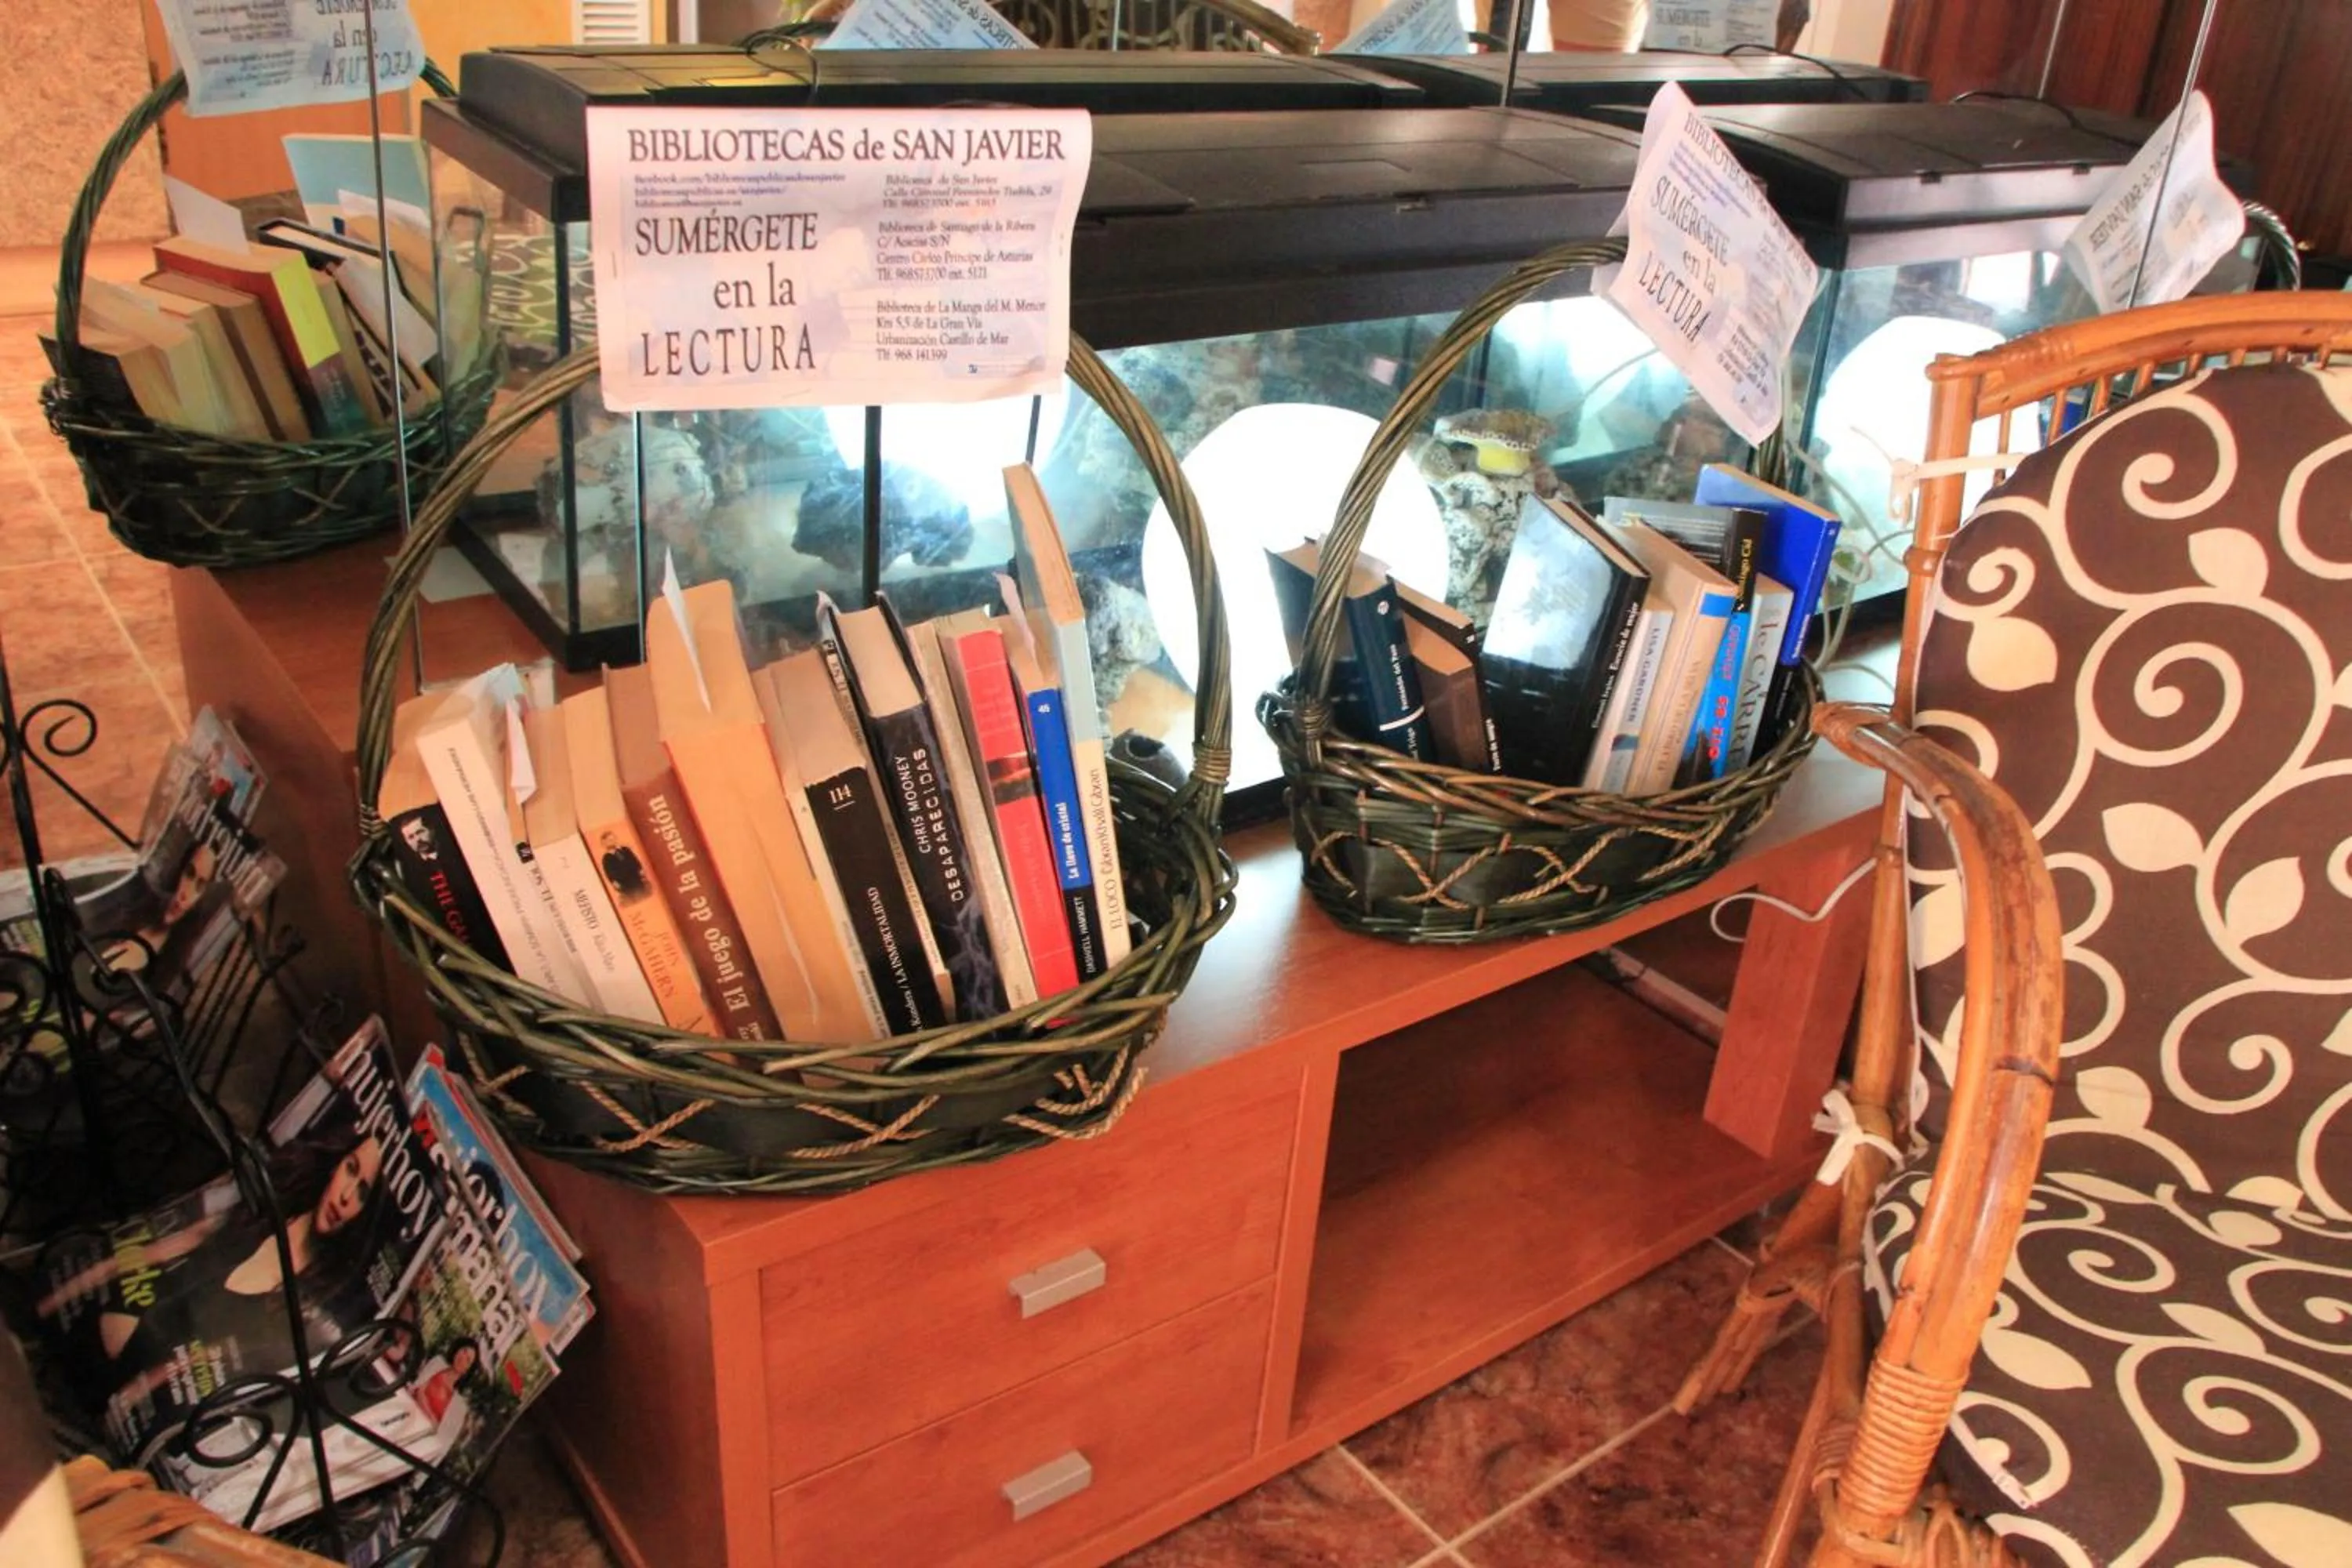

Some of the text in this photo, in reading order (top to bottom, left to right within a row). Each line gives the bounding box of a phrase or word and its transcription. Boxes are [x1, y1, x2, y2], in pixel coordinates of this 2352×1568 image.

[627, 128, 1066, 167] BIBLIOTECAS de SAN JAVIER
[635, 208, 818, 256] SUMÉRGETE
[926, 221, 938, 233] de
[1650, 176, 1731, 267] SUMÉRGETE
[983, 251, 995, 263] de
[1682, 249, 1718, 296] en la
[713, 261, 797, 310] en la
[877, 300, 922, 314] Biblioteca
[924, 301, 936, 313] de
[938, 300, 951, 313] La
[951, 301, 982, 315] Manga
[984, 299, 999, 313] del
[1014, 299, 1047, 312] Menor
[1637, 250, 1712, 343] LECTURA
[876, 317, 893, 328] Km
[913, 316, 925, 328] de
[926, 316, 938, 329] La
[940, 317, 964, 329] Gran
[976, 332, 989, 345] de
[990, 333, 1009, 345] Mar
[640, 321, 816, 377] LECTURA
[895, 755, 920, 809] MOONEY
[648, 793, 695, 866] pasión
[909, 808, 932, 855] CHRIS
[913, 748, 964, 902] DESAPARECIDAS
[677, 869, 702, 894] la
[688, 895, 713, 923] de
[705, 927, 746, 993] juego
[726, 985, 752, 1013] El
